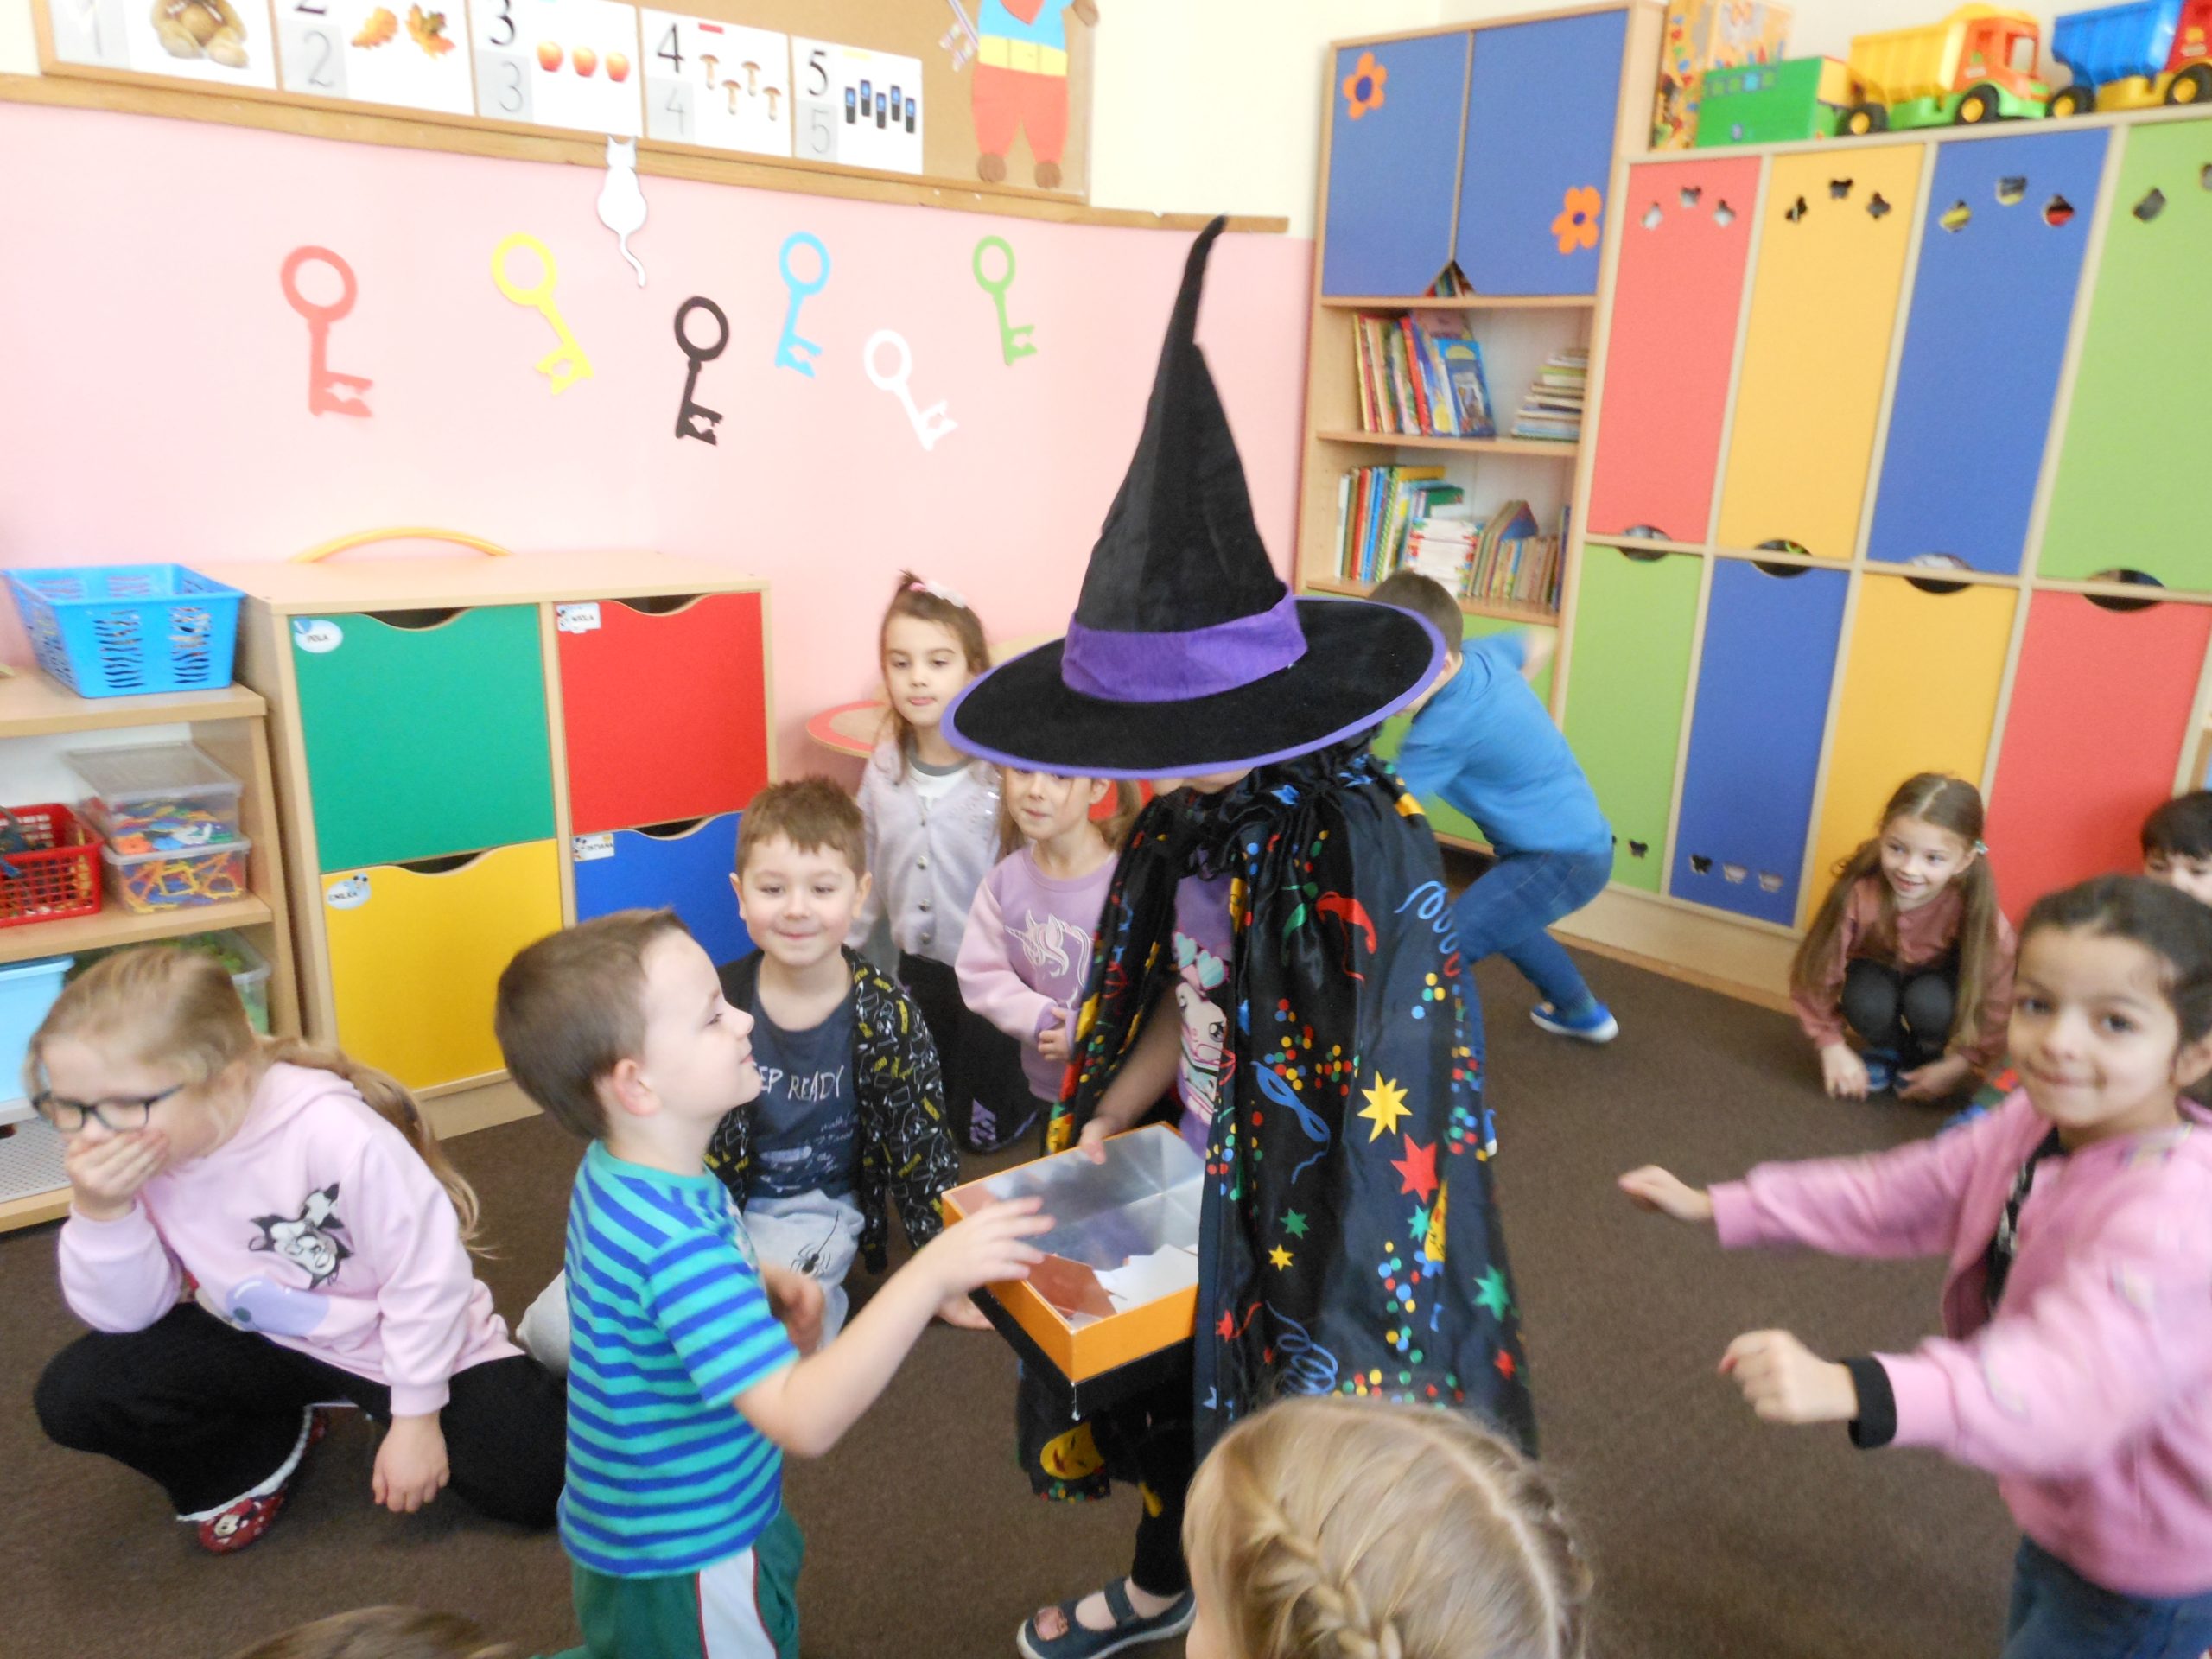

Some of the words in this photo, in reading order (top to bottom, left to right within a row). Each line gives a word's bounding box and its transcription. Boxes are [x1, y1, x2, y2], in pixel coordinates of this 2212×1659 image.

[488, 0, 516, 45] 3
[303, 30, 334, 86] 2
[657, 23, 685, 73] 4
[499, 60, 524, 112] 3
[809, 49, 830, 96] 5
[664, 87, 685, 135] 4
[812, 108, 831, 154] 5
[788, 1065, 845, 1102] READY
